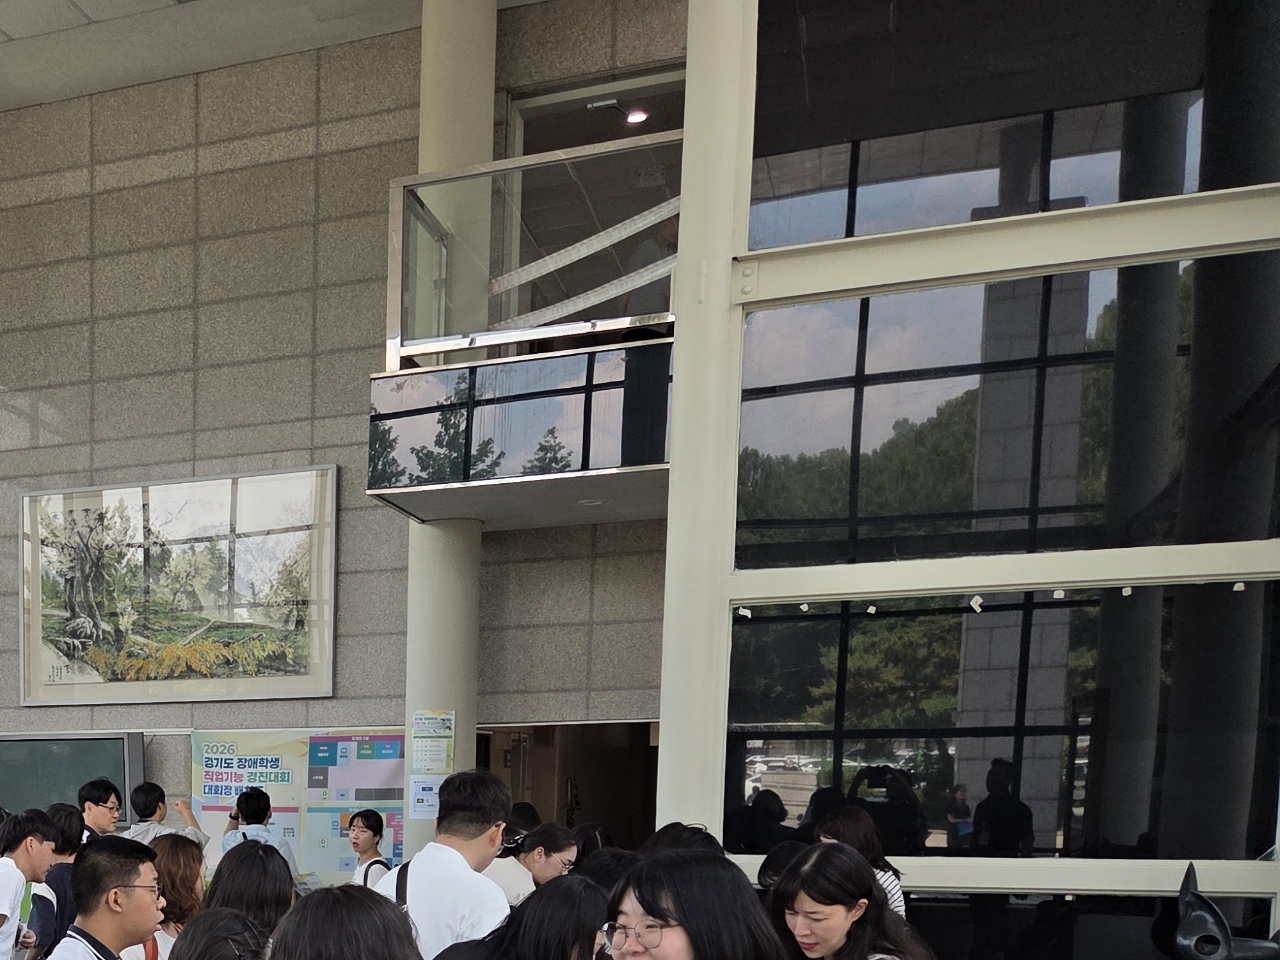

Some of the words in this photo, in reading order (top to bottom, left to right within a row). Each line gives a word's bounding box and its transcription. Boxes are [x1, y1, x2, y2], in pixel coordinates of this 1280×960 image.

[203, 743, 235, 755] 2026
[204, 756, 234, 769] 경기도
[236, 756, 280, 769] 장애학생
[203, 770, 244, 783] 직업기능
[246, 770, 290, 783] 경진대회
[203, 784, 233, 796] 대회장
